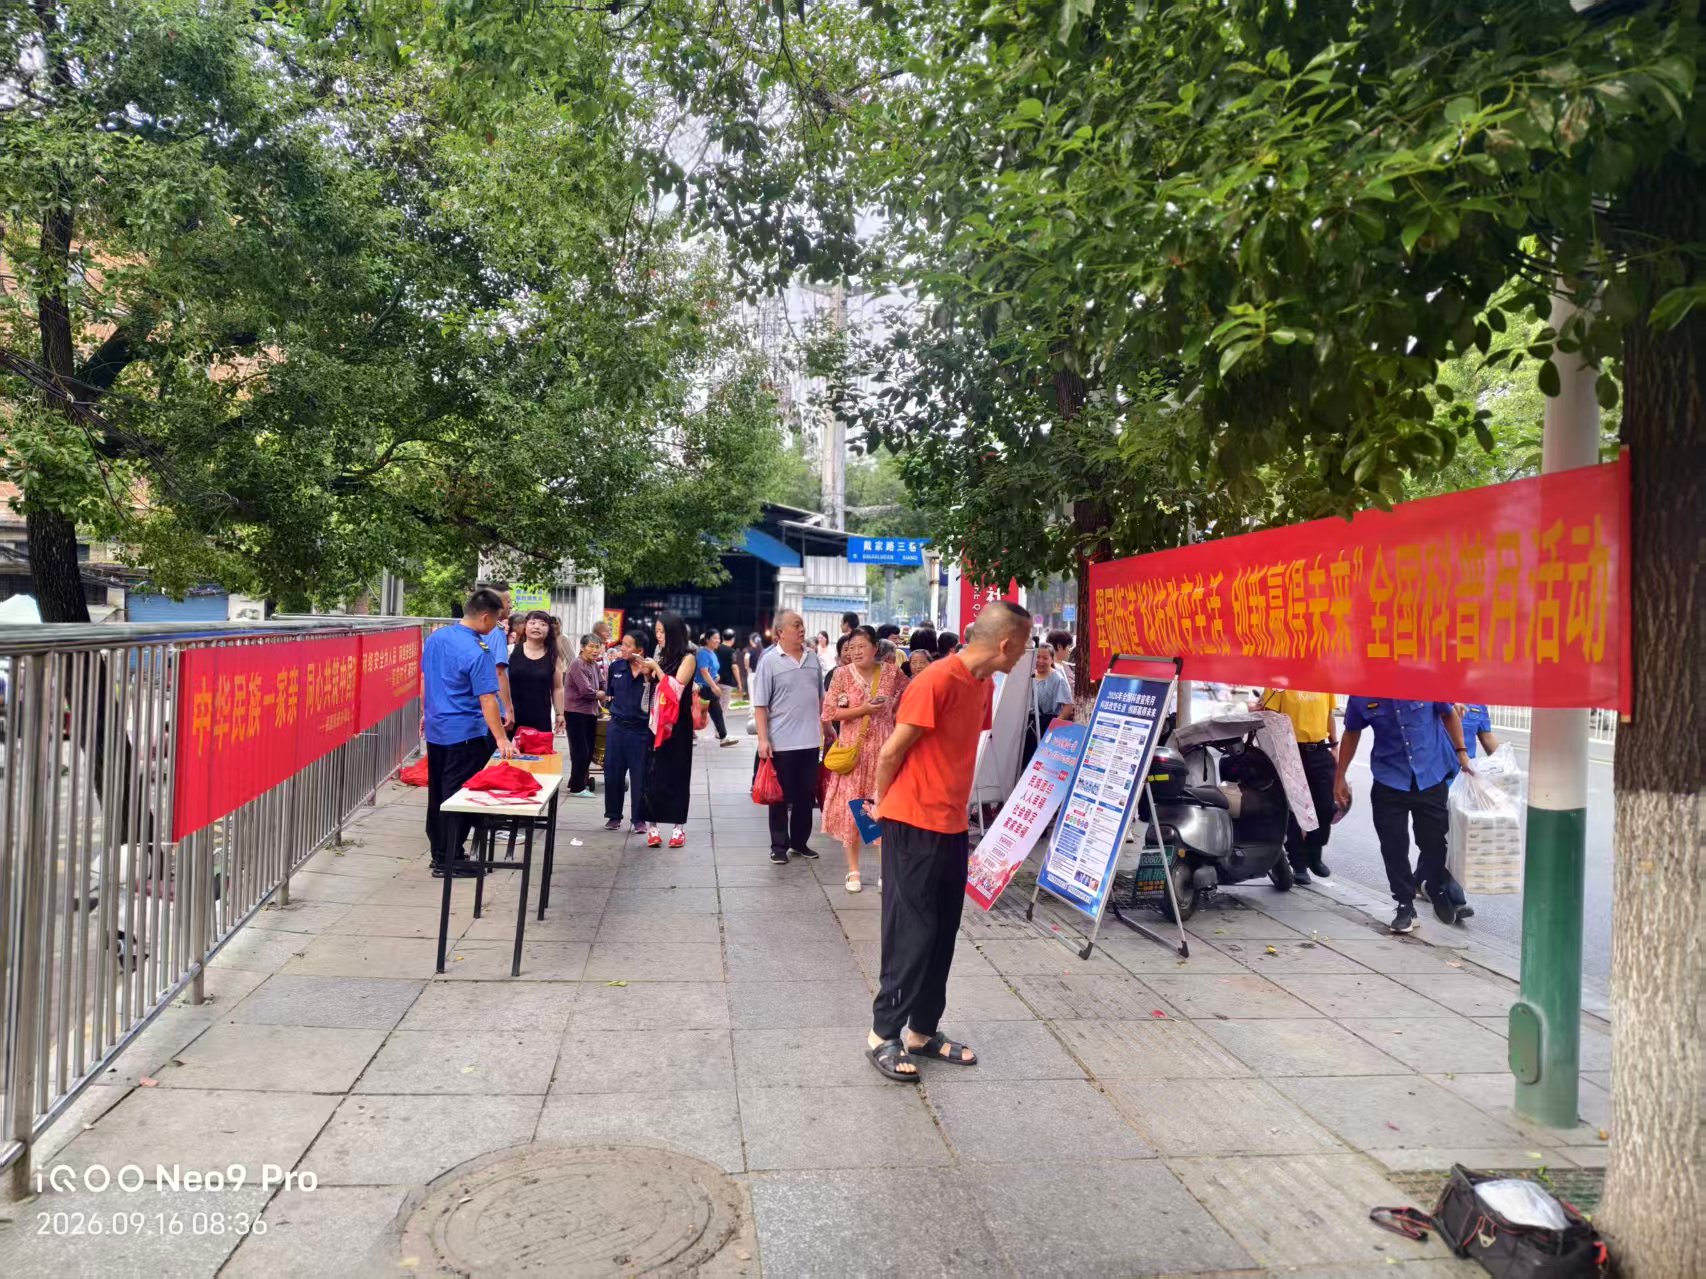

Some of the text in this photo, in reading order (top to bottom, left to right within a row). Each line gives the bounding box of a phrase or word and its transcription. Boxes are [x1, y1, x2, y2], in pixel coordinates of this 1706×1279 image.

[192, 664, 299, 757] 中华民族一家亲
